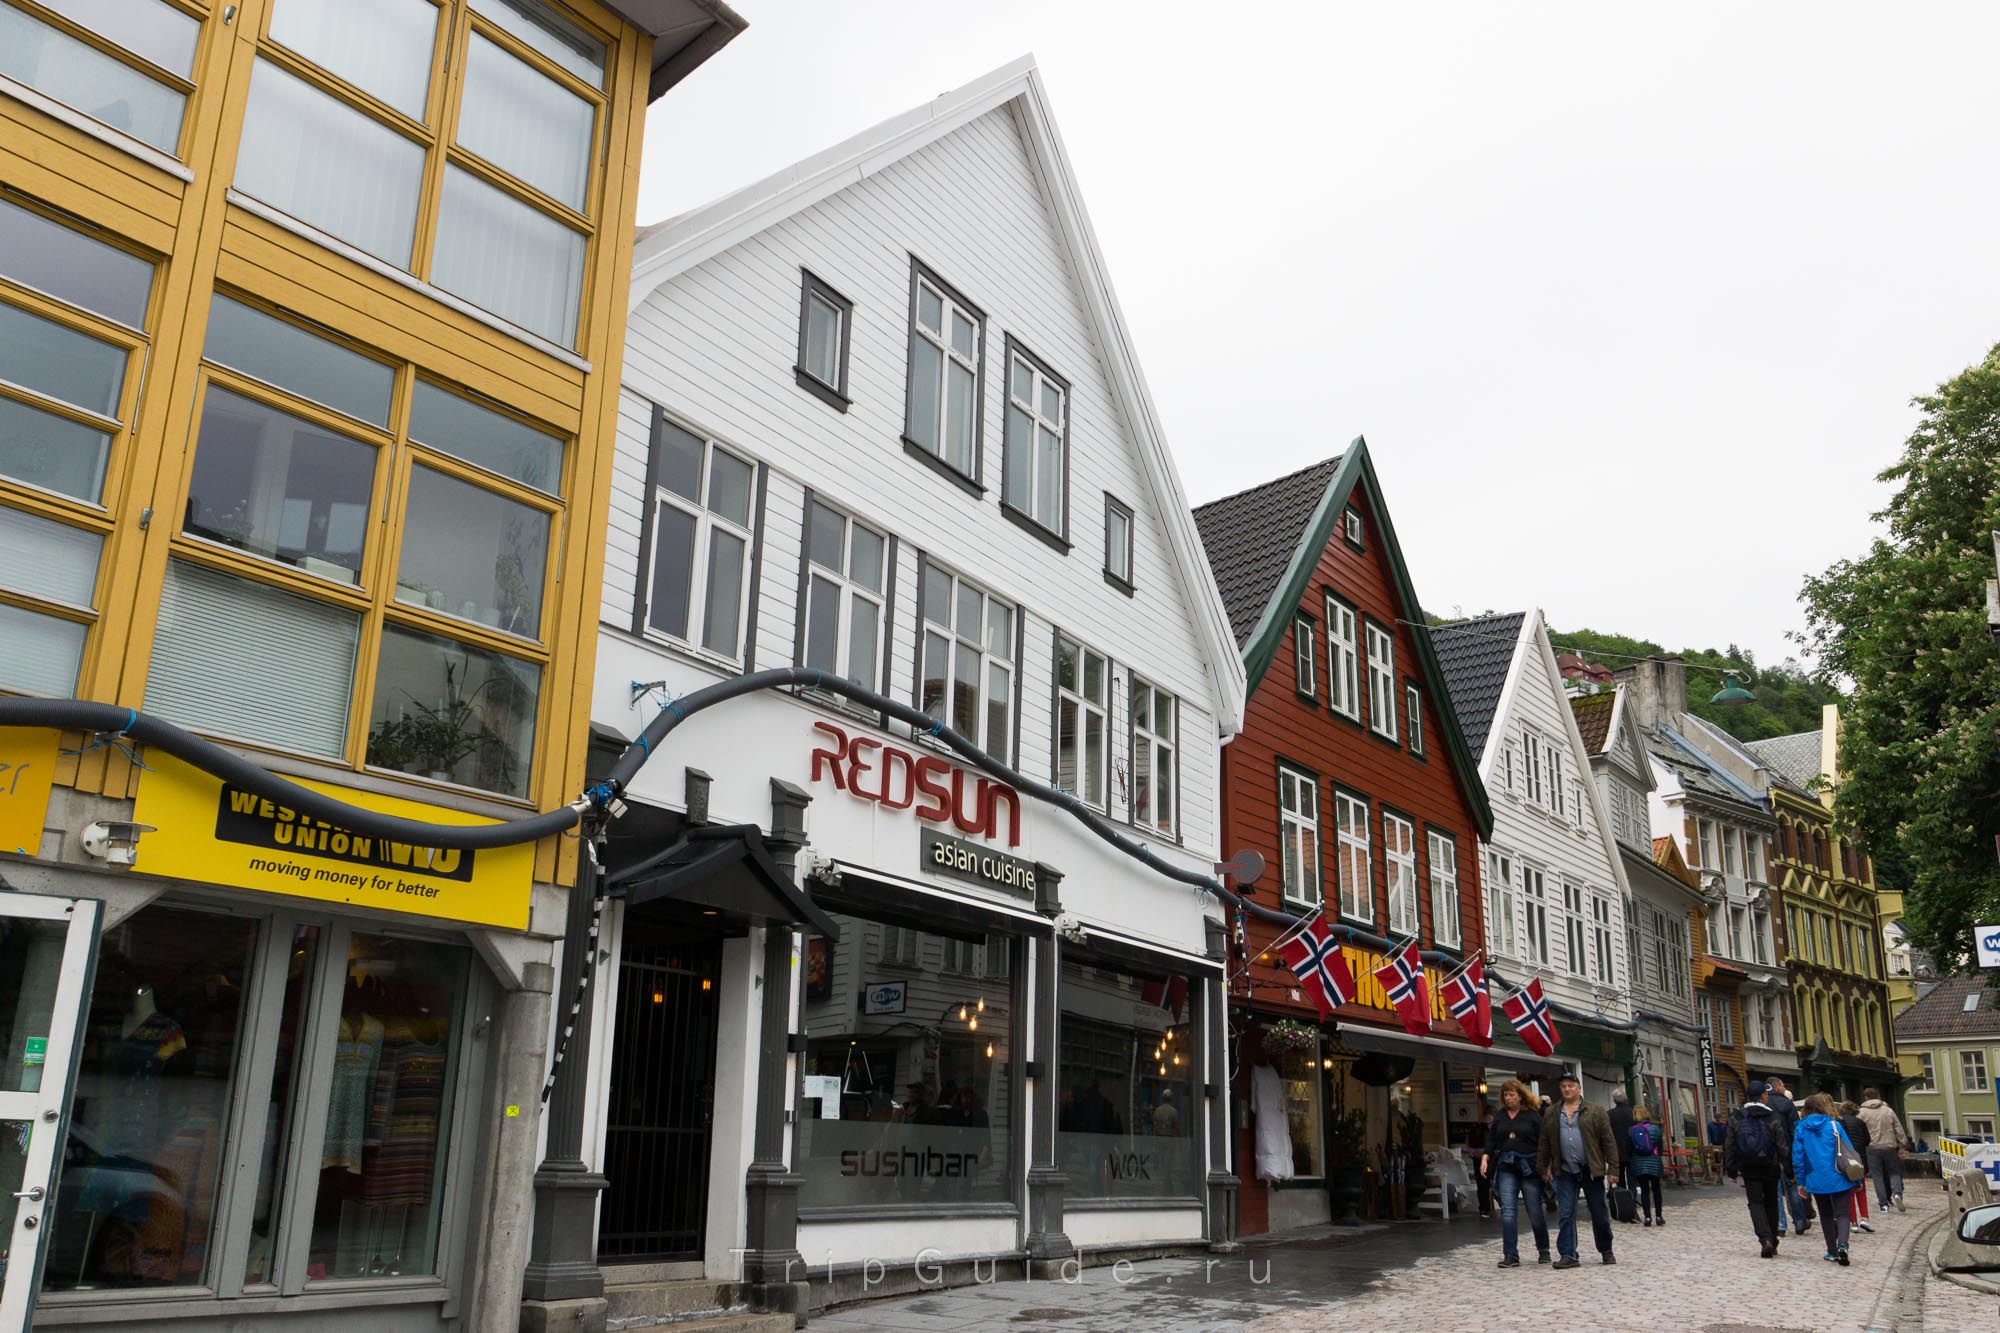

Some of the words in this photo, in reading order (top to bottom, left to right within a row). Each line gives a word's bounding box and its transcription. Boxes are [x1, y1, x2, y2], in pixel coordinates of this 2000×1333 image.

[273, 822, 371, 858] UNION
[249, 857, 311, 881] moving
[314, 869, 368, 890] money
[371, 875, 393, 891] for
[396, 879, 440, 899] better
[934, 841, 978, 874] asian
[982, 856, 1035, 891] cuisine
[1700, 1040, 1714, 1086] KAFFE
[841, 1146, 979, 1177] sushibar
